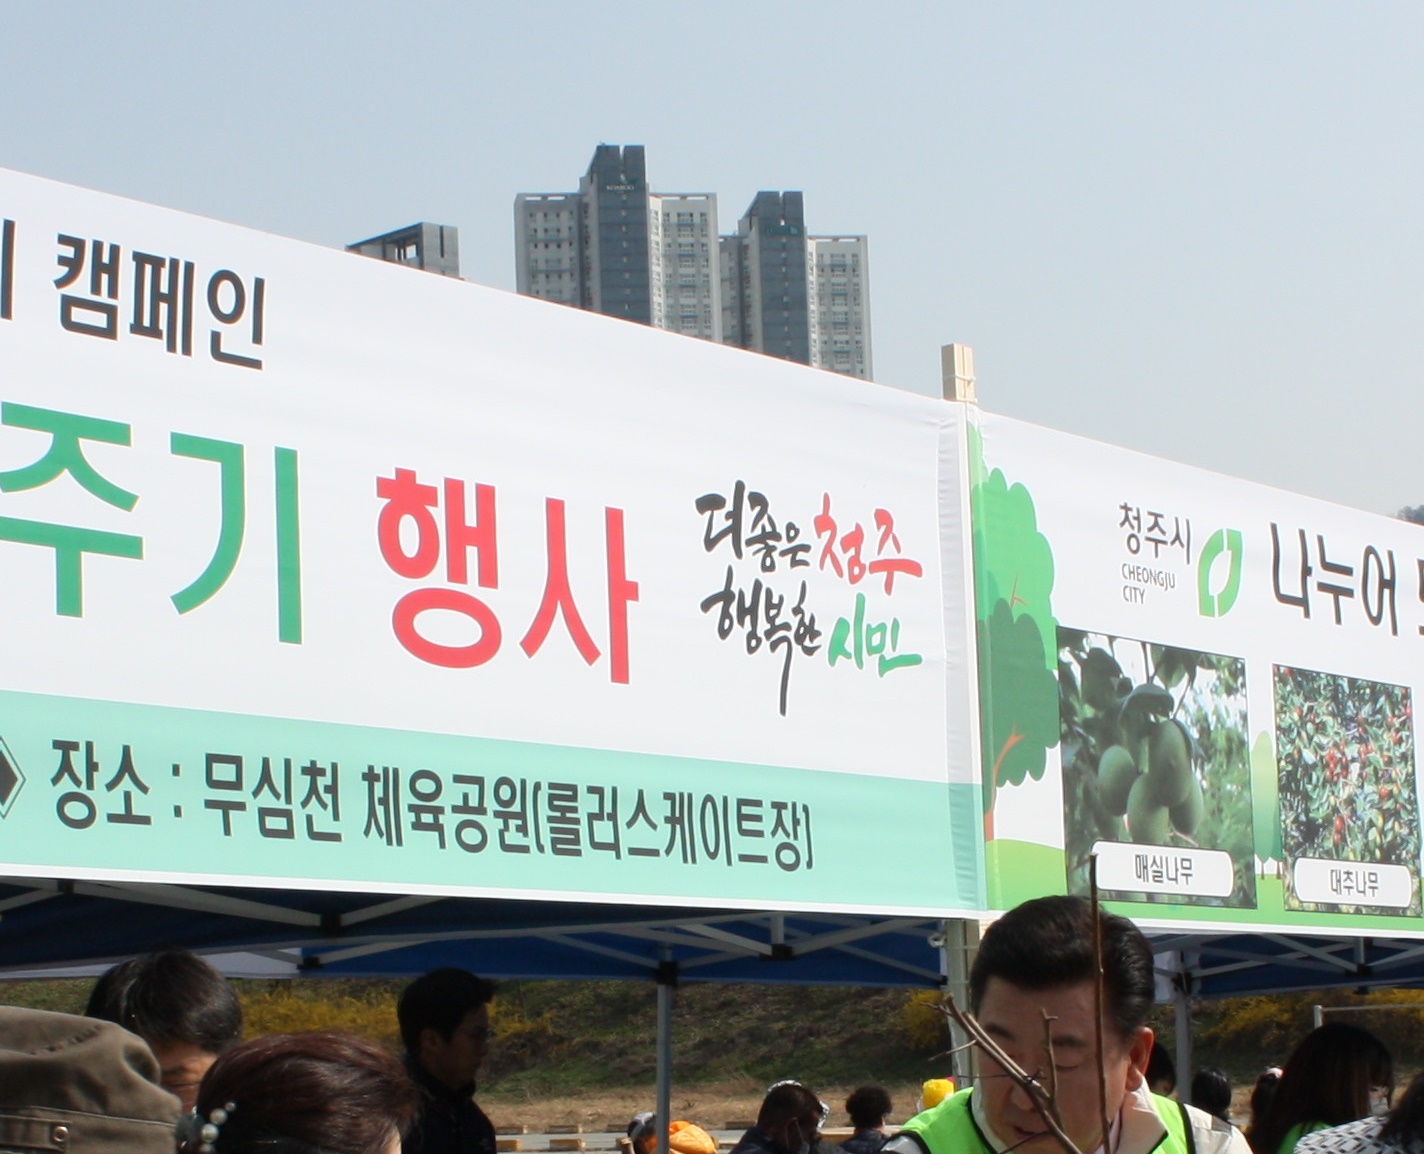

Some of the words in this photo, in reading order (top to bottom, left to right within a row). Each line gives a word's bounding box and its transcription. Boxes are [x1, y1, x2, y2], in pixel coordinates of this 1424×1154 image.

[53, 231, 265, 371] 캠페인
[376, 466, 640, 685] 행사
[813, 491, 923, 596] 청주
[1119, 501, 1191, 565] 청주시
[1121, 562, 1176, 592] CHEONGJU
[1270, 521, 1399, 637] 나누어
[700, 563, 823, 717] 행복한
[827, 591, 924, 679] 시민
[1122, 584, 1146, 605] CITY
[49, 738, 153, 830] 장소
[203, 750, 343, 844] 무심천
[360, 763, 815, 875] 체육공원(롤러스케이트장)
[1133, 853, 1195, 886] 매실나무
[1329, 869, 1380, 898] 대추나무
